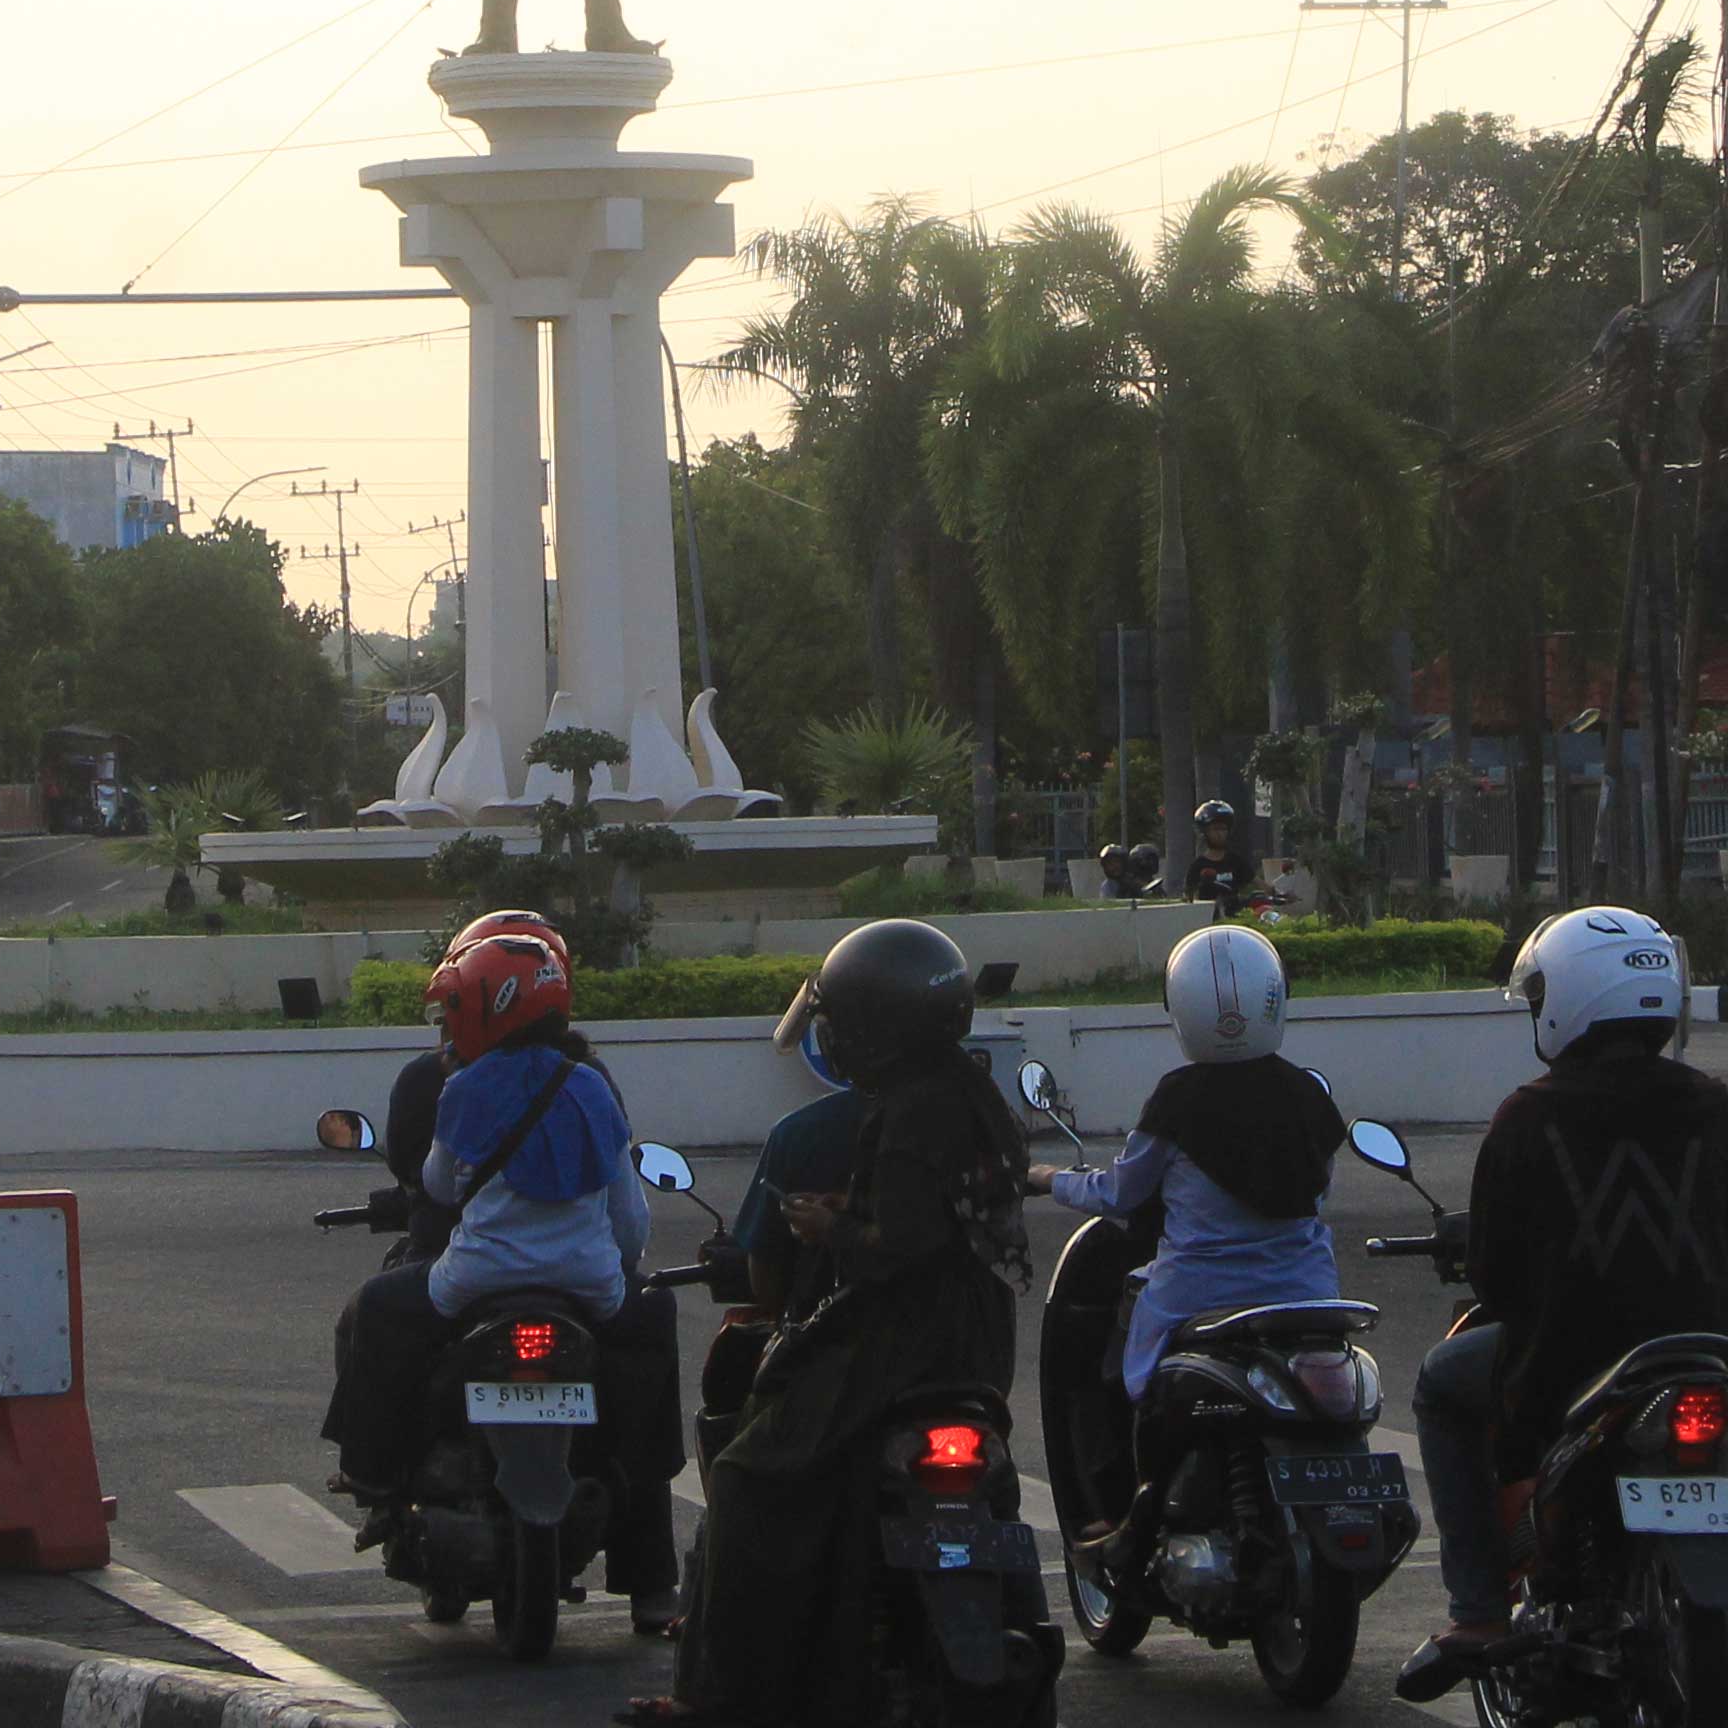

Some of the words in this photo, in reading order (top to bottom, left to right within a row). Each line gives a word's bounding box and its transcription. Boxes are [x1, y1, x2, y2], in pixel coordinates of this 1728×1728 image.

[1626, 951, 1667, 967] KYT
[474, 1386, 486, 1402] S
[499, 1386, 545, 1402] 6151
[560, 1386, 584, 1402] FN
[1625, 1482, 1643, 1503] S
[1659, 1482, 1716, 1504] 6297
